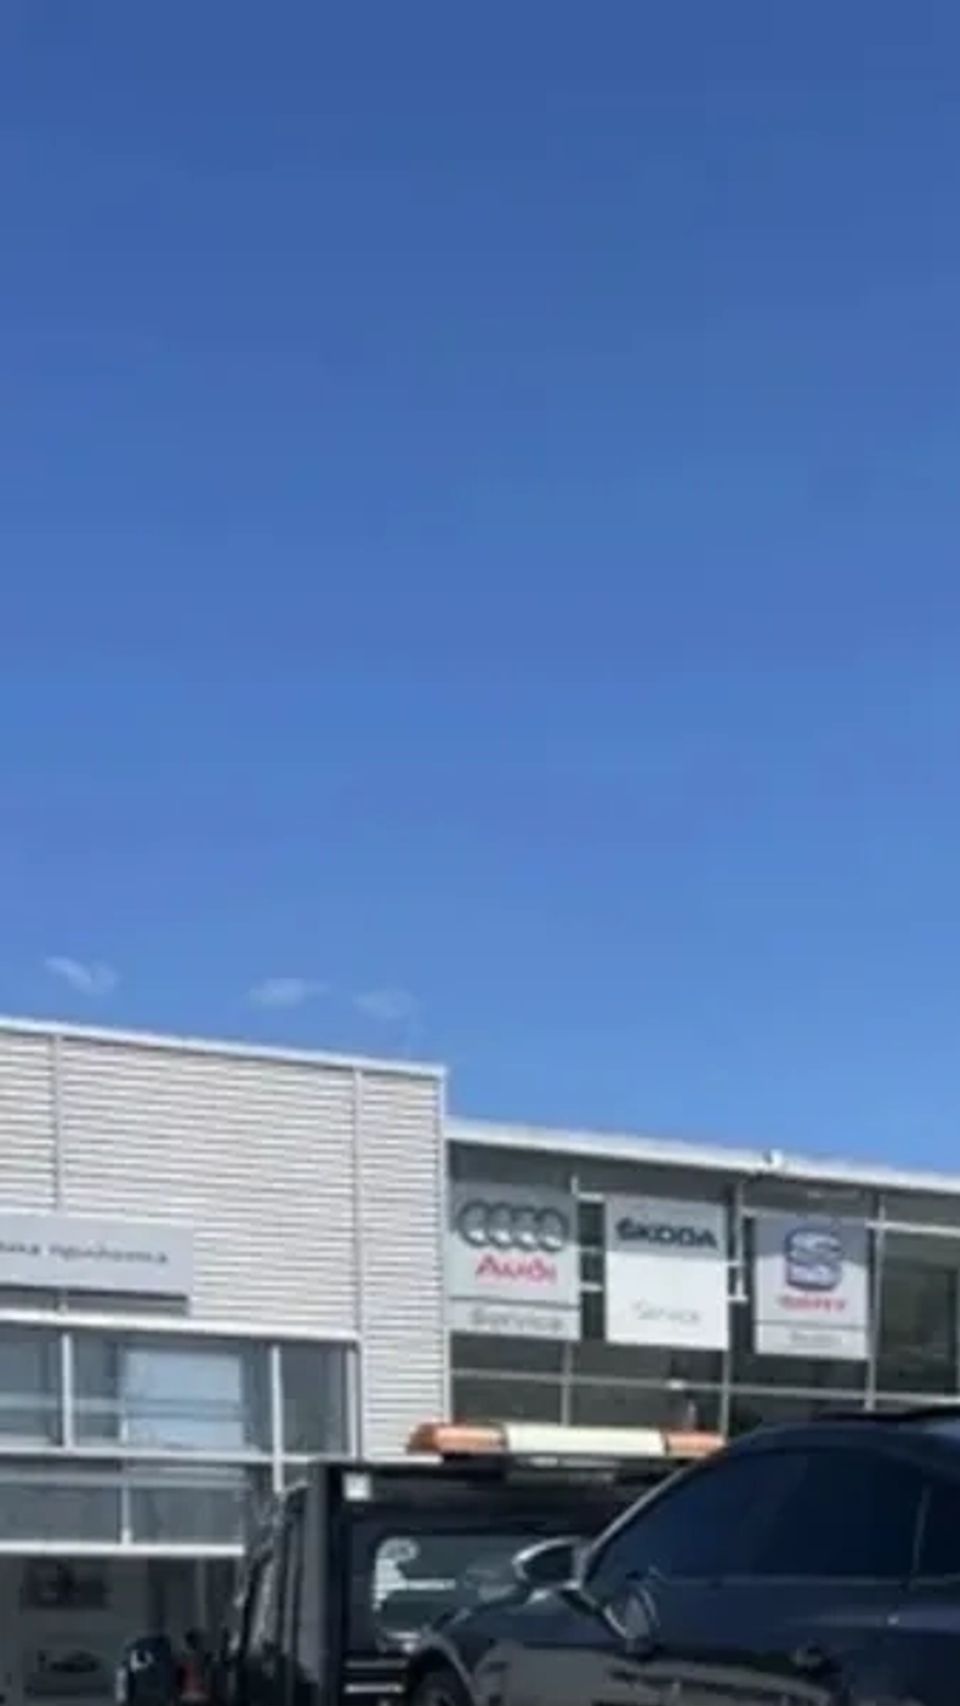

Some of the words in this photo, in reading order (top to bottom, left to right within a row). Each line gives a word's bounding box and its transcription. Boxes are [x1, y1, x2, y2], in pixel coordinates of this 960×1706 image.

[475, 1253, 558, 1283] Audi
[469, 1306, 564, 1332] Service
[632, 1299, 703, 1325] Service
